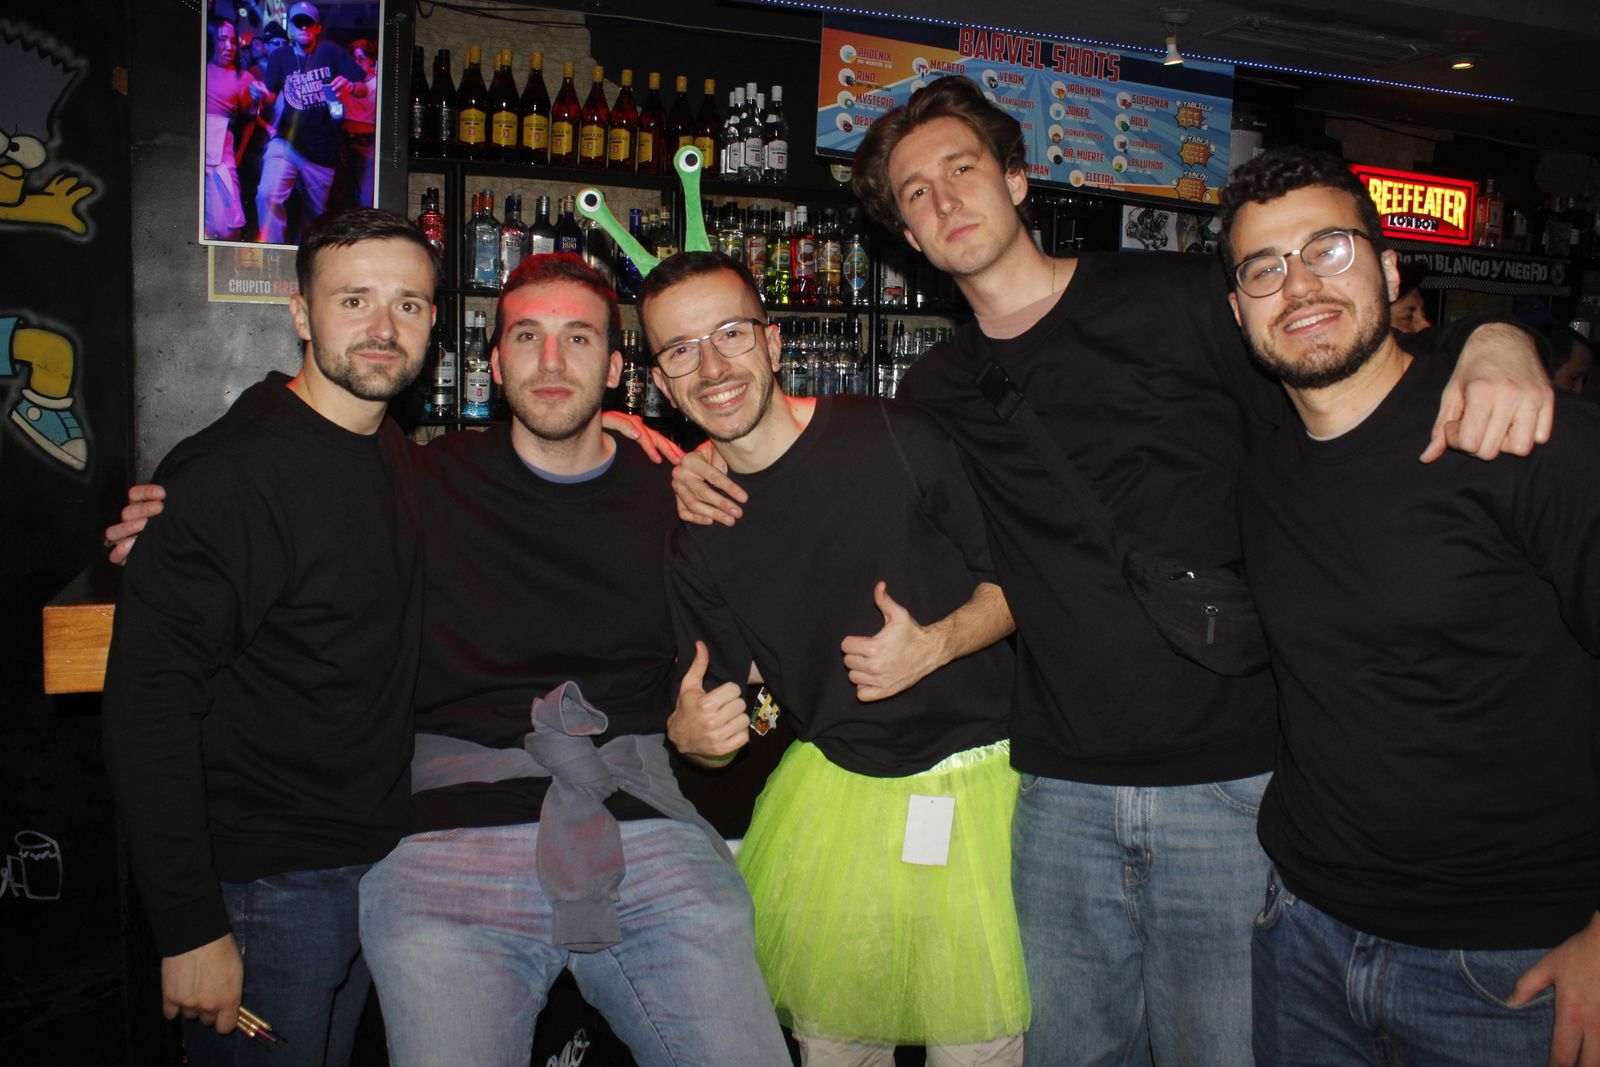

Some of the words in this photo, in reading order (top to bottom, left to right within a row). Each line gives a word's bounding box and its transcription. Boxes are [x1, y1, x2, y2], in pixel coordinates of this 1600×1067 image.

[857, 47, 893, 62] PHOENIX
[958, 27, 1045, 70] BARVEL
[1051, 46, 1121, 83] SHOTS
[930, 59, 966, 74] MAGNETO
[999, 71, 1025, 84] VENOM
[1067, 83, 1084, 95] IRON
[1086, 86, 1102, 97] MAN
[855, 93, 895, 110] MYSTERIO
[1131, 94, 1169, 110] SUPERMAN
[1065, 104, 1090, 118] JOKER
[853, 114, 878, 127] DEAD
[1129, 115, 1149, 128] HULK
[1076, 148, 1105, 163] MUERTE
[1085, 171, 1115, 185] ELECTRA
[1369, 177, 1467, 231] BEEFEATER
[1387, 215, 1439, 232] LONDON
[561, 241, 577, 249] 1880
[1435, 253, 1490, 277] BLANCO
[1491, 259, 1504, 278] Y
[1505, 261, 1549, 282] NEGRO
[228, 279, 271, 293] CHUPITO
[272, 281, 299, 295] FIRE
